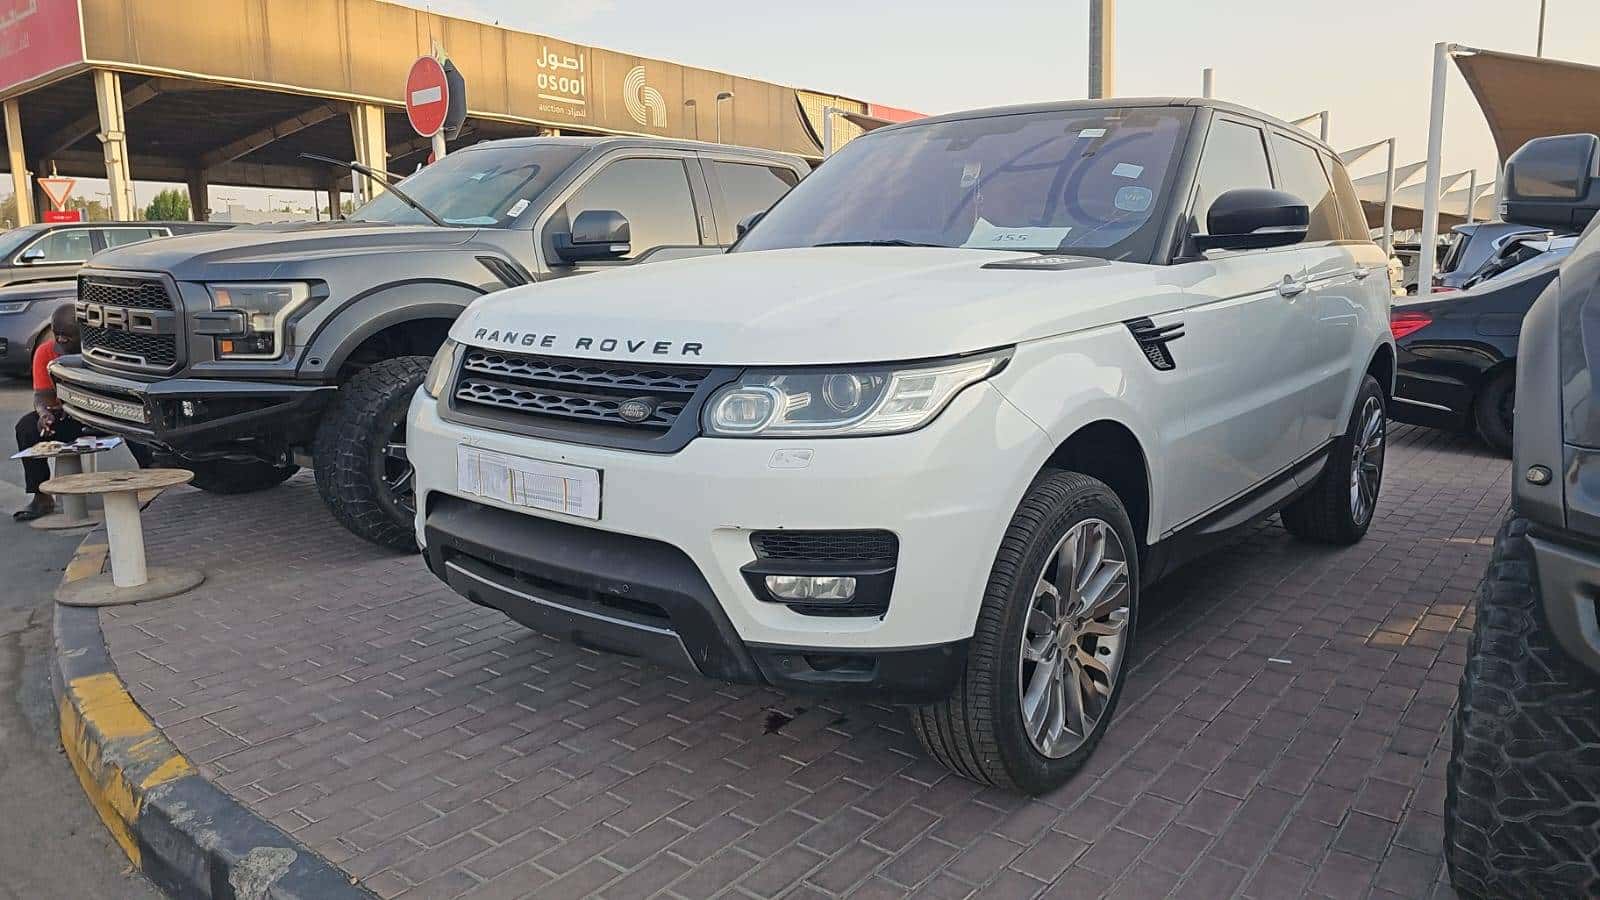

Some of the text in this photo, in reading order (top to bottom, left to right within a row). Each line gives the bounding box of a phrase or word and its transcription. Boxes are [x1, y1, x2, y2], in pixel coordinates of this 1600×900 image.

[537, 73, 585, 97] osool
[538, 103, 565, 114] auction
[475, 327, 704, 356] RANGE ROVER
